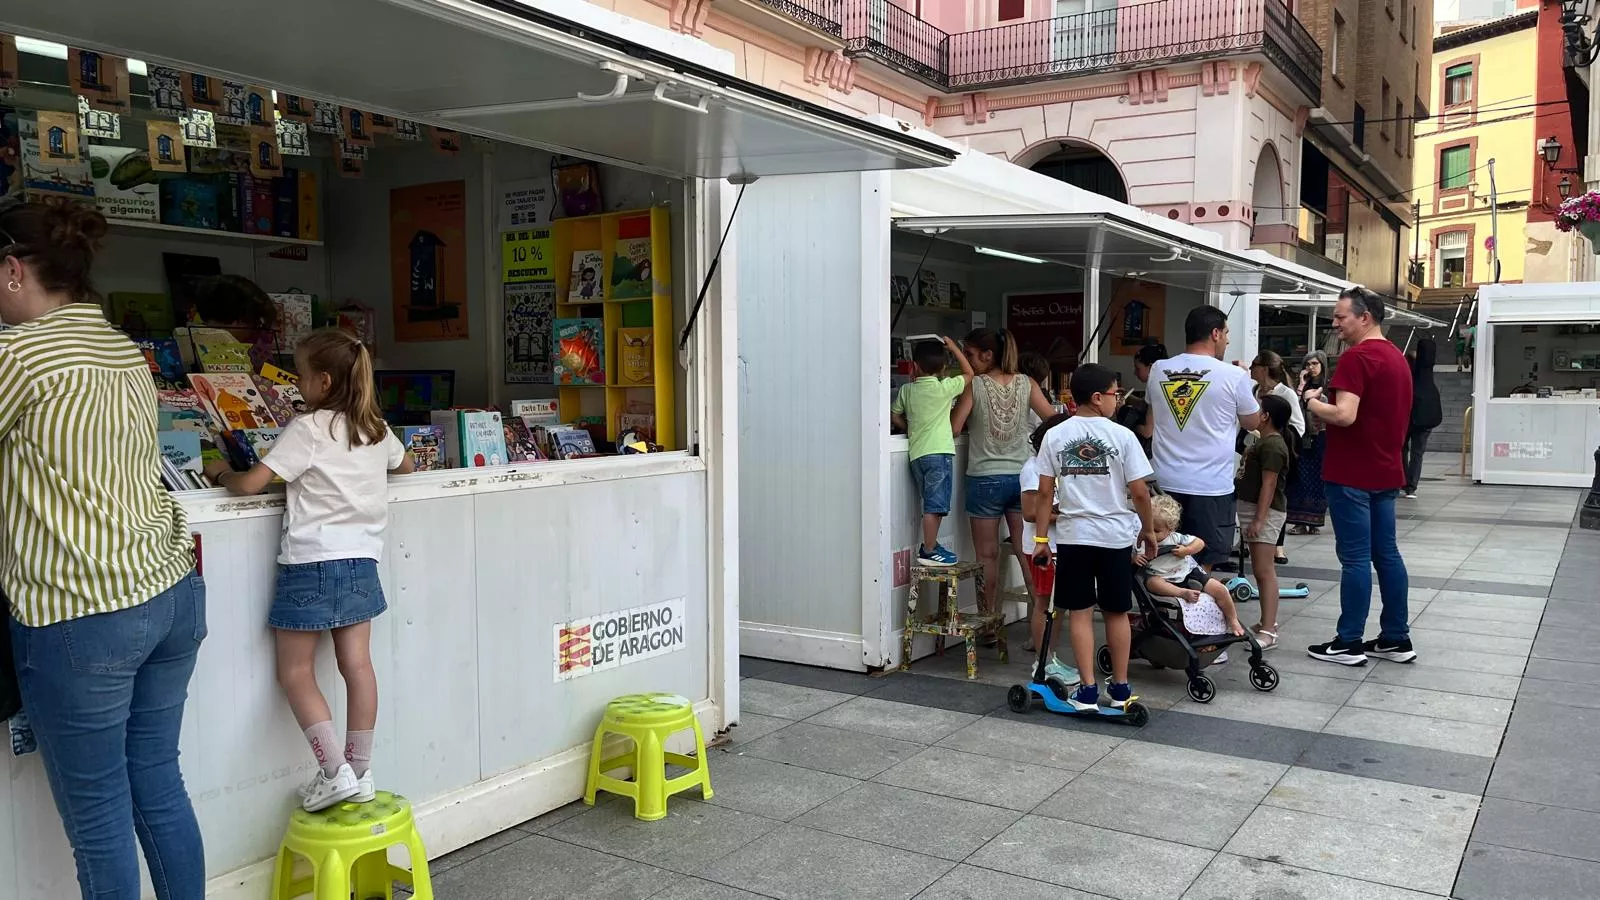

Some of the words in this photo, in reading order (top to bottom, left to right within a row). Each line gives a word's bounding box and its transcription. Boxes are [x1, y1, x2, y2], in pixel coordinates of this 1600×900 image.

[97, 195, 156, 206] nosaurios
[110, 205, 156, 217] gigantes
[512, 246, 527, 262] 10
[531, 245, 543, 261] %
[592, 606, 673, 641] GOBIERNO
[592, 642, 614, 664] DE
[620, 625, 683, 658] ARAGON
[345, 743, 354, 763] ORS
